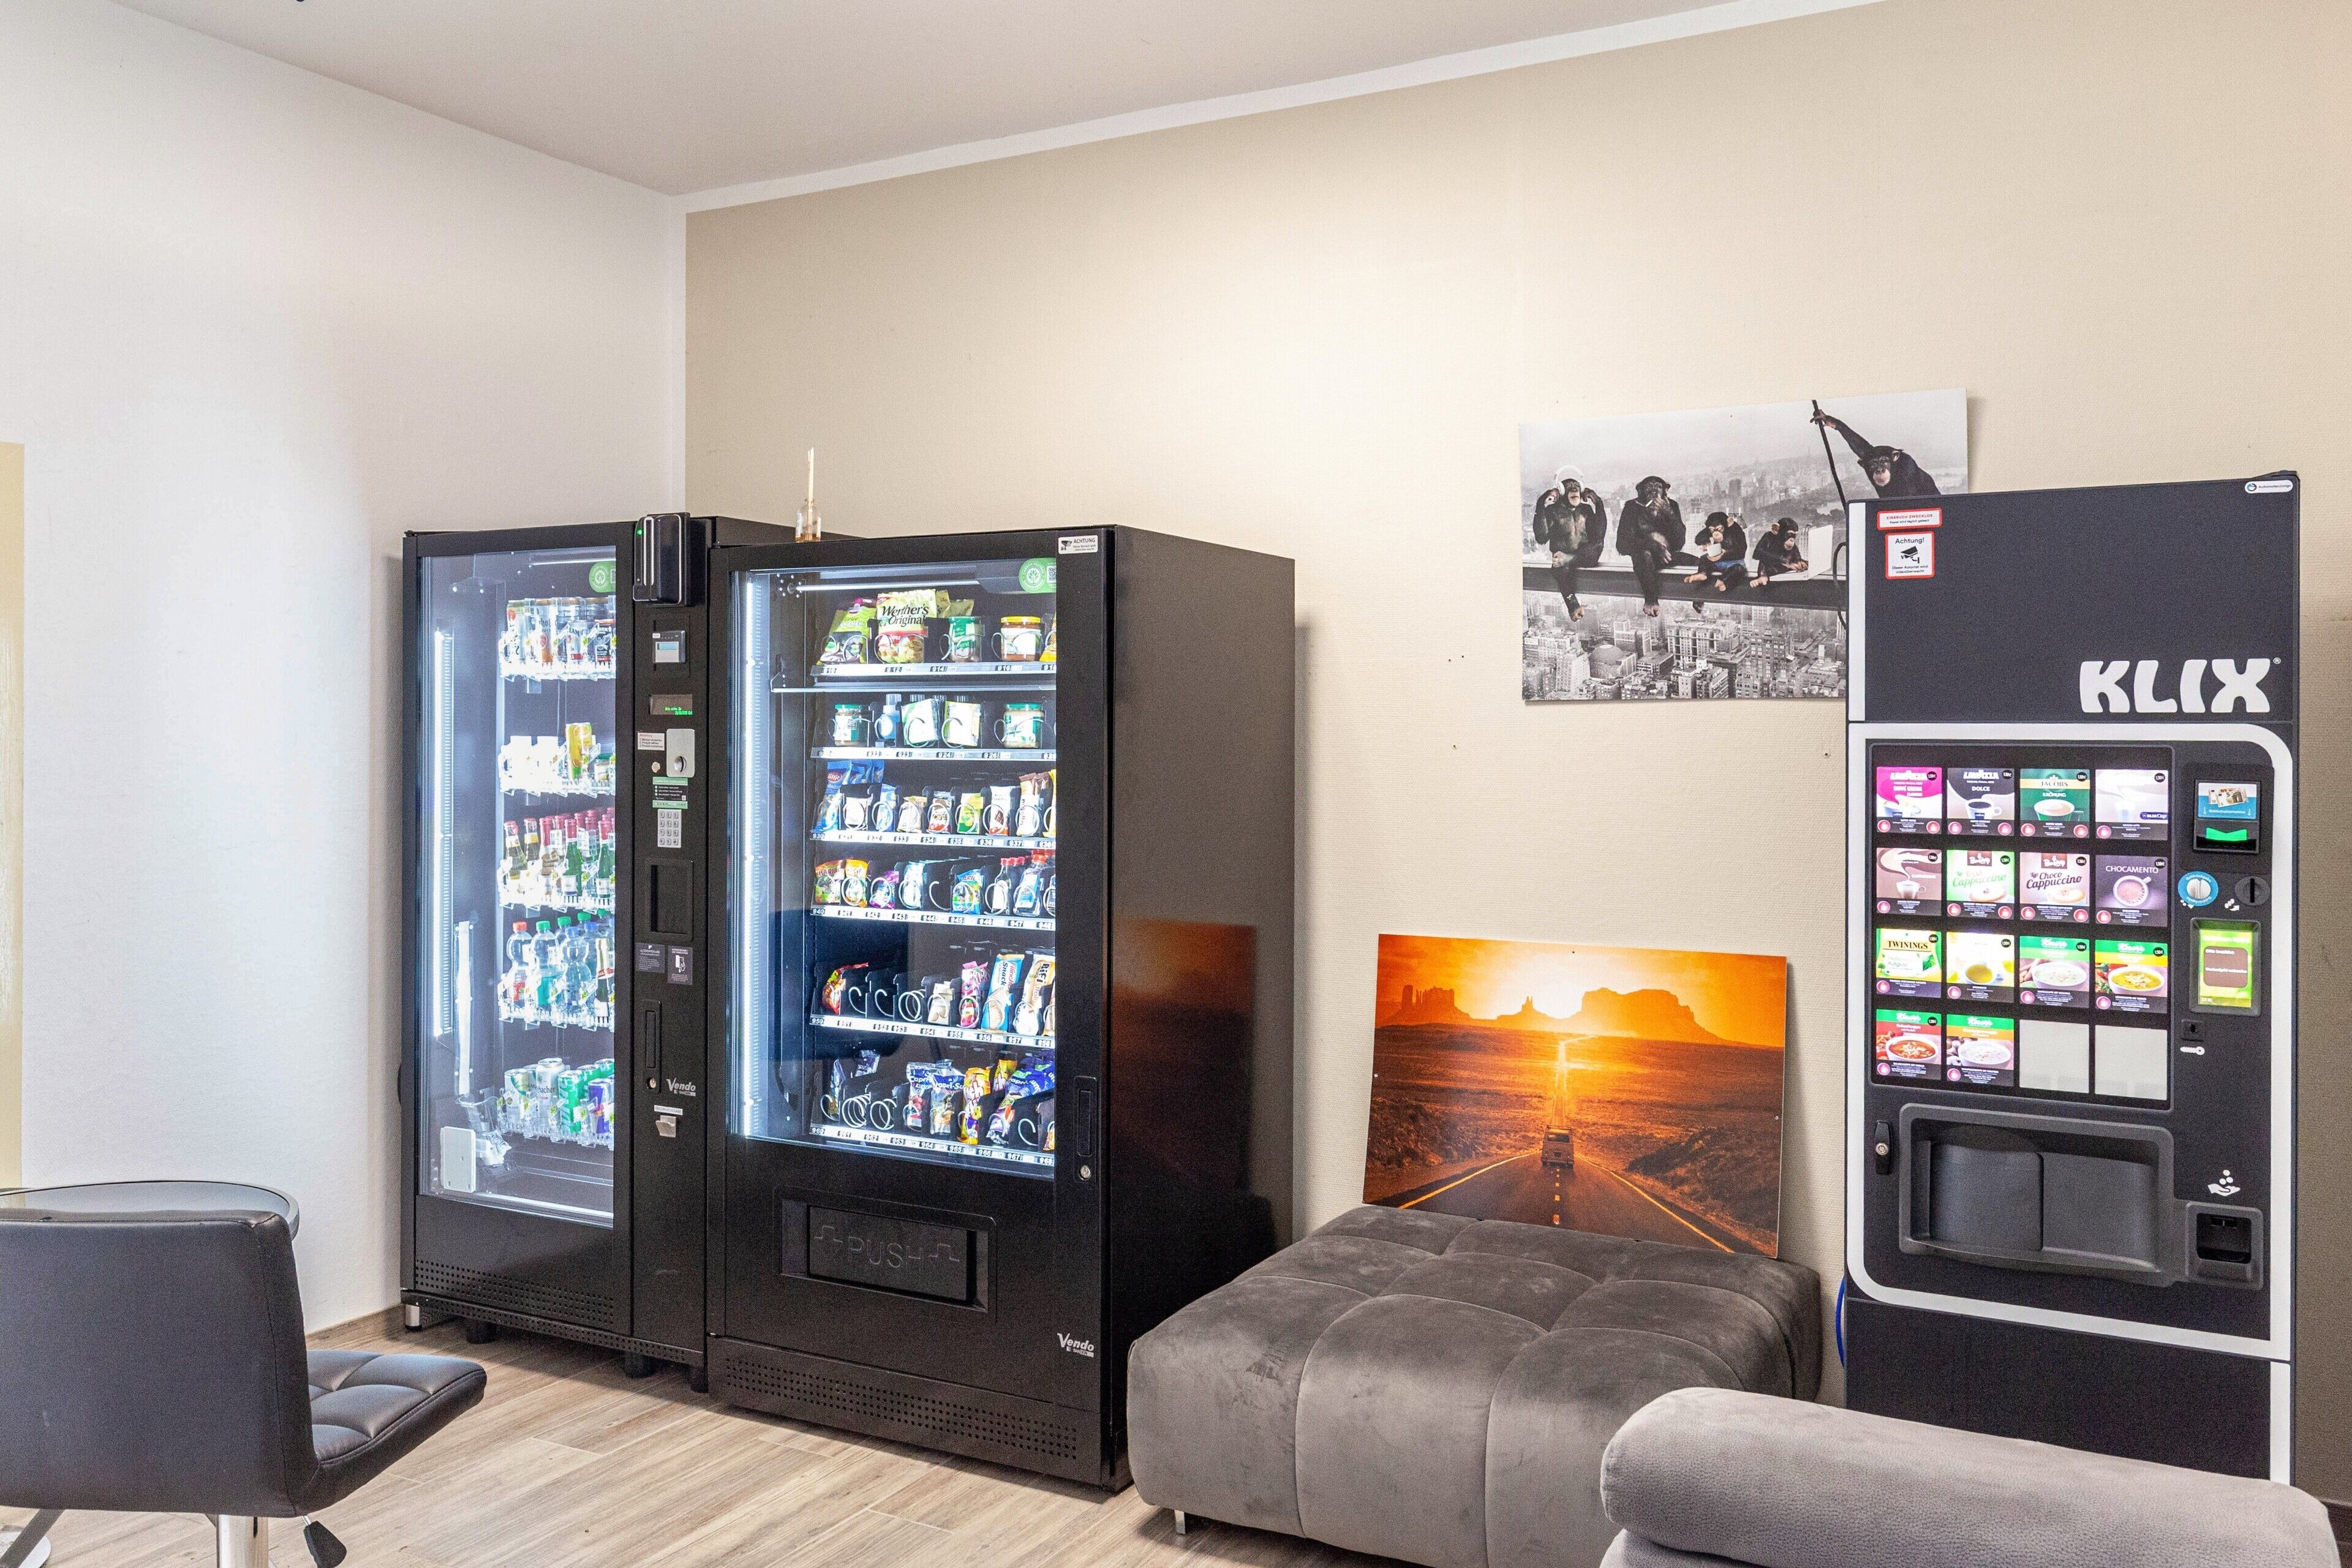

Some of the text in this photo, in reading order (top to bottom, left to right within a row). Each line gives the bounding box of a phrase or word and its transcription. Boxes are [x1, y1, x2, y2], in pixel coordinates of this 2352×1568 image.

[883, 603, 929, 617] Werther's
[888, 616, 924, 627] Original
[2039, 872, 2062, 880] Choco
[2105, 865, 2159, 874] CHOCAMENTO
[1952, 873, 2007, 888] Cappuccino
[2026, 875, 2082, 890] Cappuccino
[1887, 940, 1928, 949] TWININGS
[1036, 963, 1050, 984] BiFi
[666, 1077, 696, 1091] Vendo
[848, 1236, 922, 1269] PUSH
[1057, 1332, 1095, 1351] Vendo
